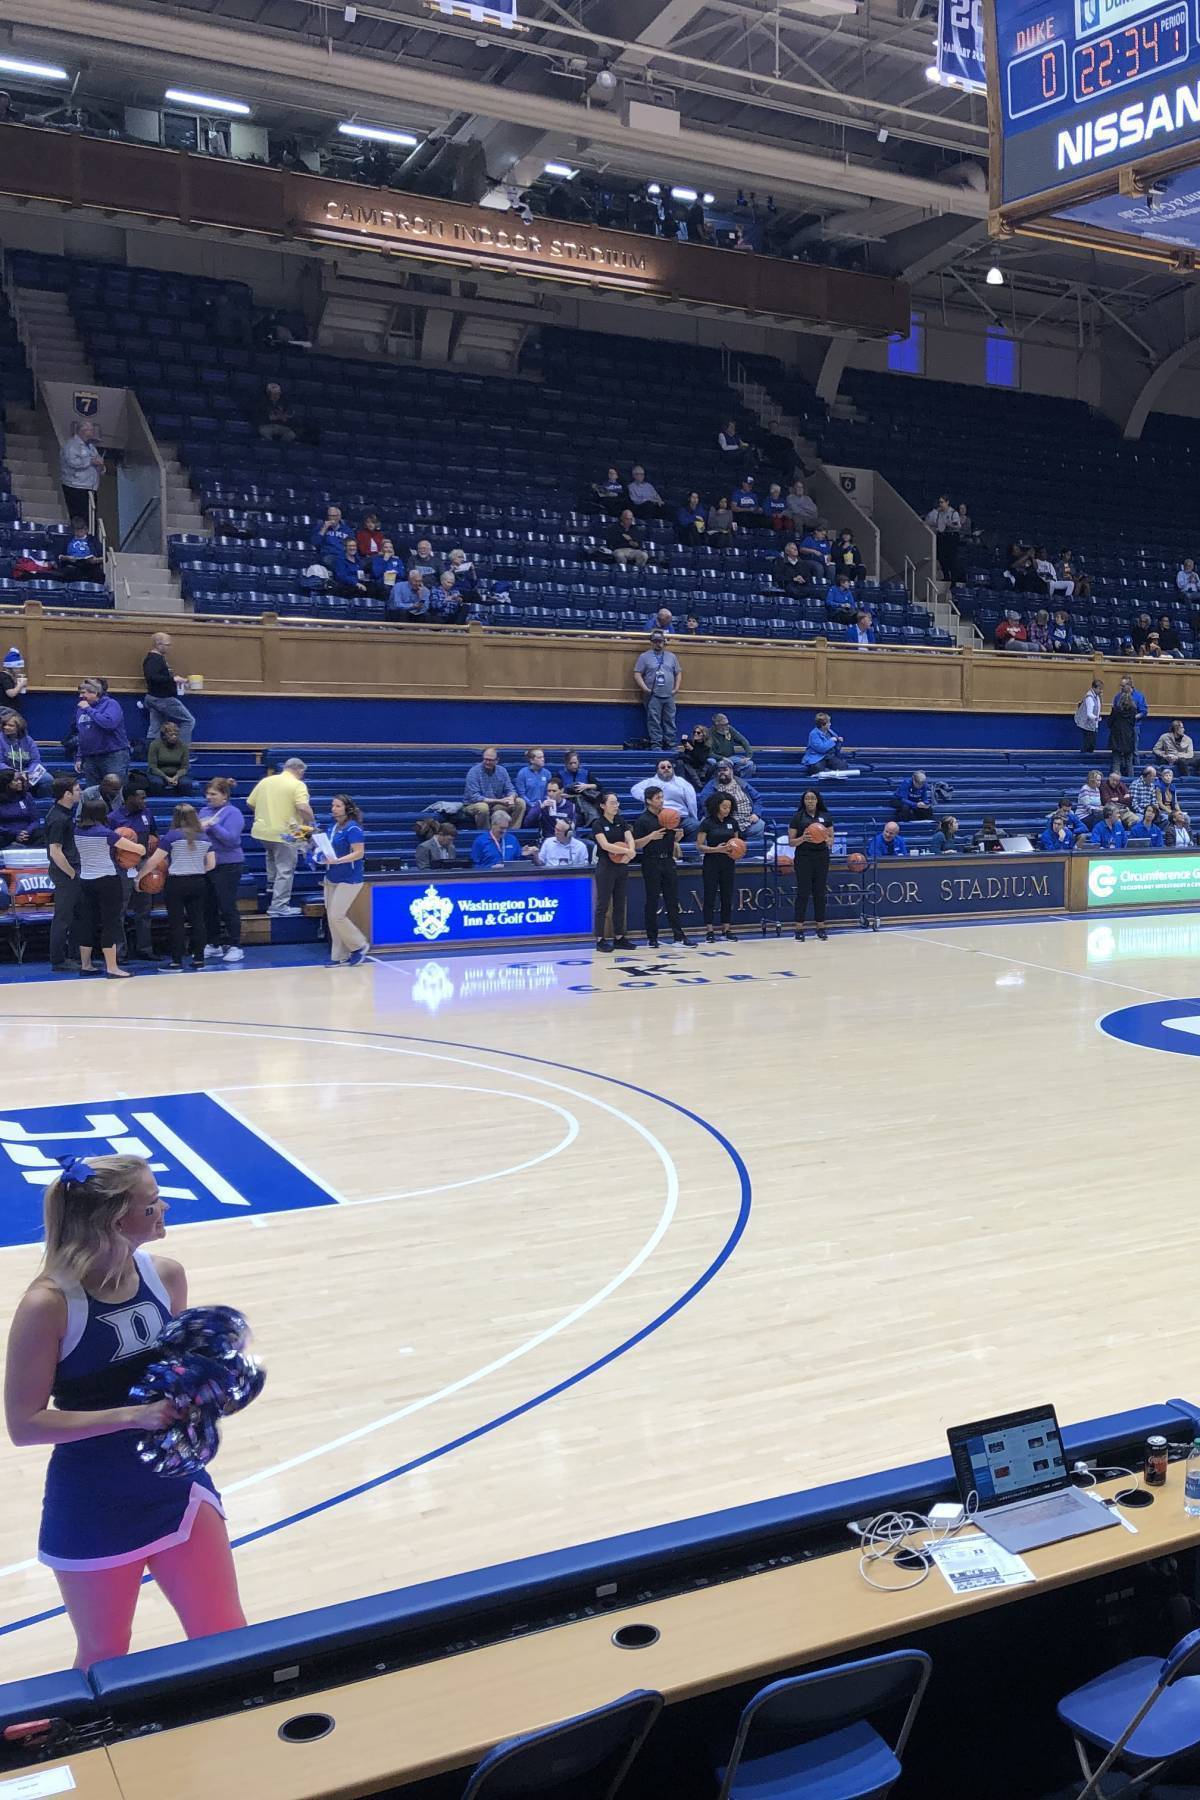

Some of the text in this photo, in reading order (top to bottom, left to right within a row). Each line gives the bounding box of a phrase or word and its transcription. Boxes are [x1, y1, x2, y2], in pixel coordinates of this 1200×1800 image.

[1160, 11, 1185, 32] PERIOD
[1016, 17, 1055, 51] DUKE
[1081, 22, 1159, 94] 22:34
[1041, 52, 1056, 98] 0
[325, 202, 648, 271] CAMERON INDOOR STADIUM
[81, 398, 92, 412] 7
[940, 874, 1051, 902] STADIUM
[1120, 870, 1191, 883] Circumference
[457, 896, 559, 914] Washington Duke
[463, 911, 554, 927] Inn & Golf Club
[566, 970, 799, 993] COURT
